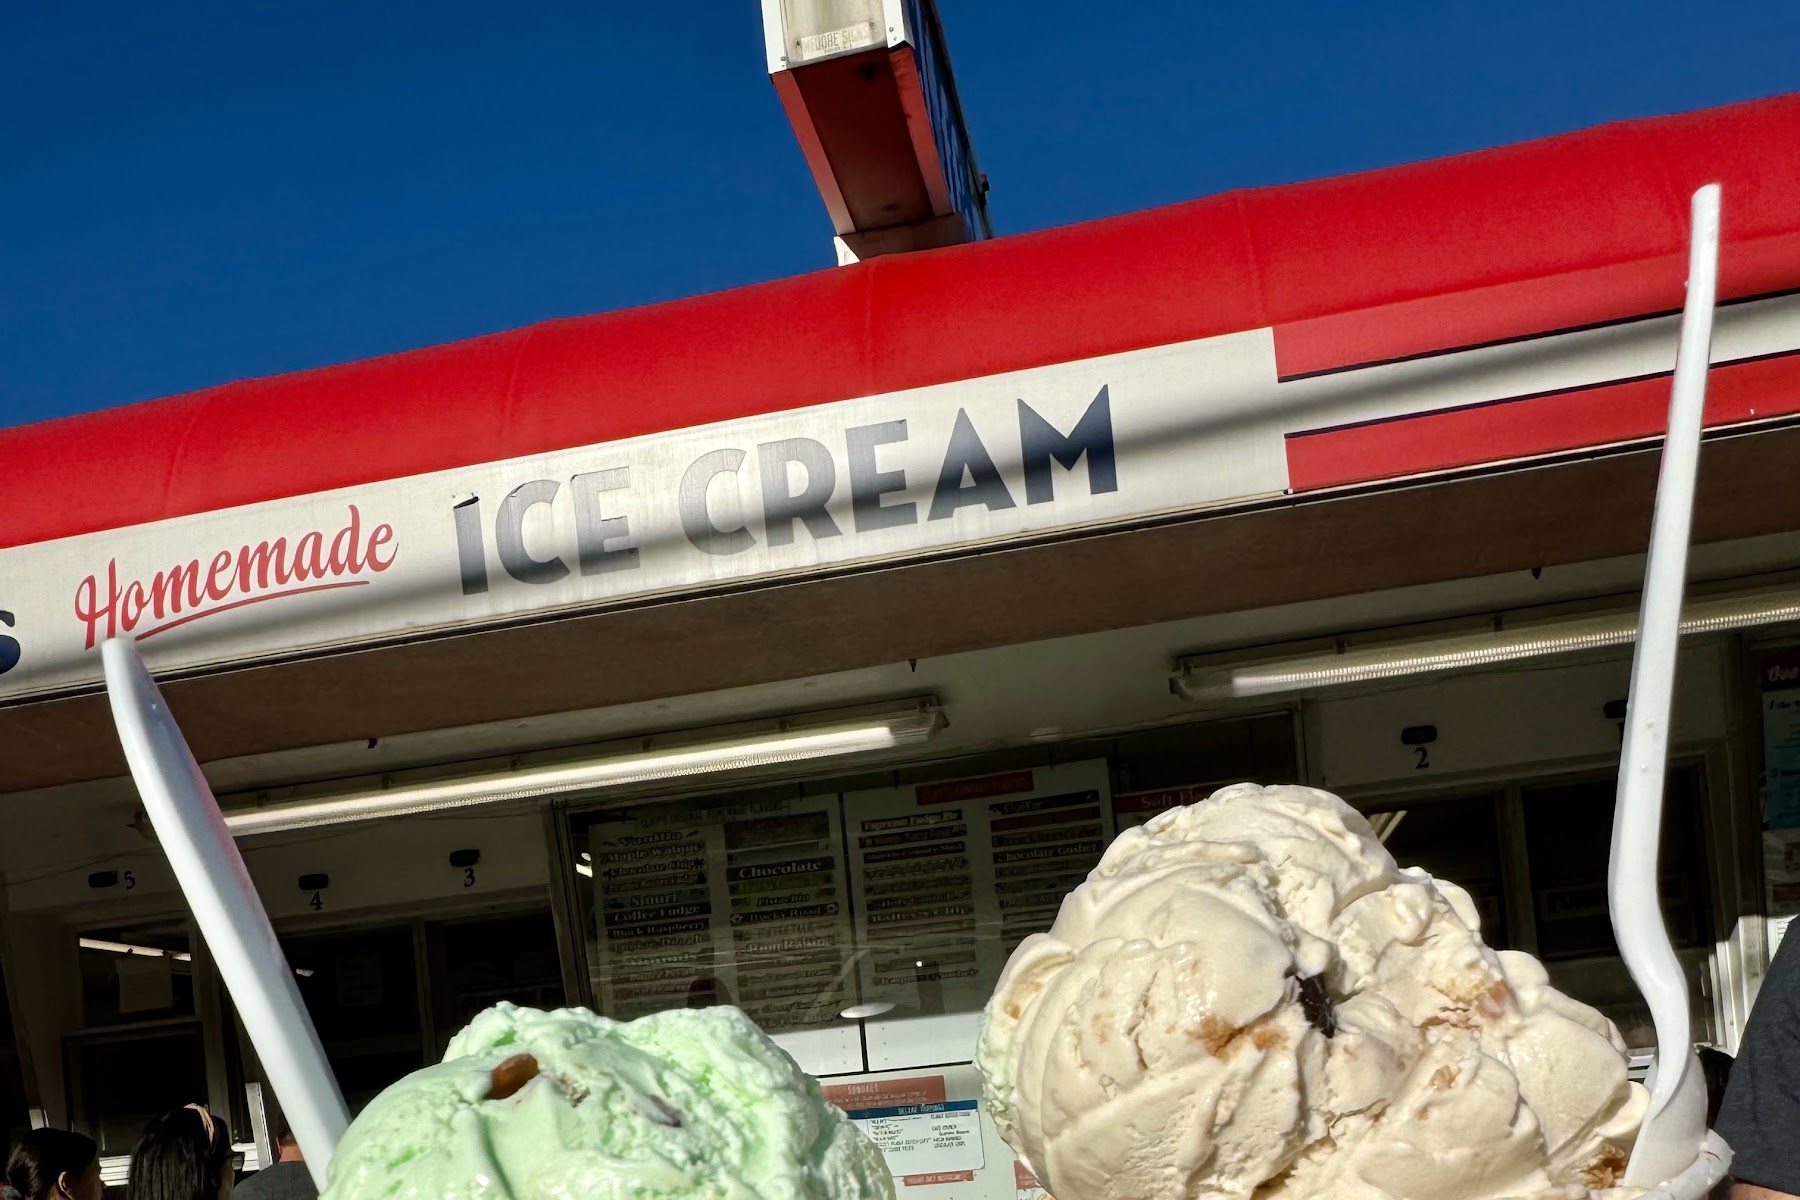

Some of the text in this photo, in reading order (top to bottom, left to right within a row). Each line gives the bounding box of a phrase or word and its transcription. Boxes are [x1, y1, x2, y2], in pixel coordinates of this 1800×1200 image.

[74, 504, 399, 650] Homemade
[452, 465, 641, 595] ICE
[679, 384, 1119, 555] CREAM
[1414, 747, 1430, 769] 2
[123, 870, 136, 889] 5
[463, 868, 476, 888] 3
[738, 861, 822, 879] Chocolate
[309, 891, 323, 911] 4
